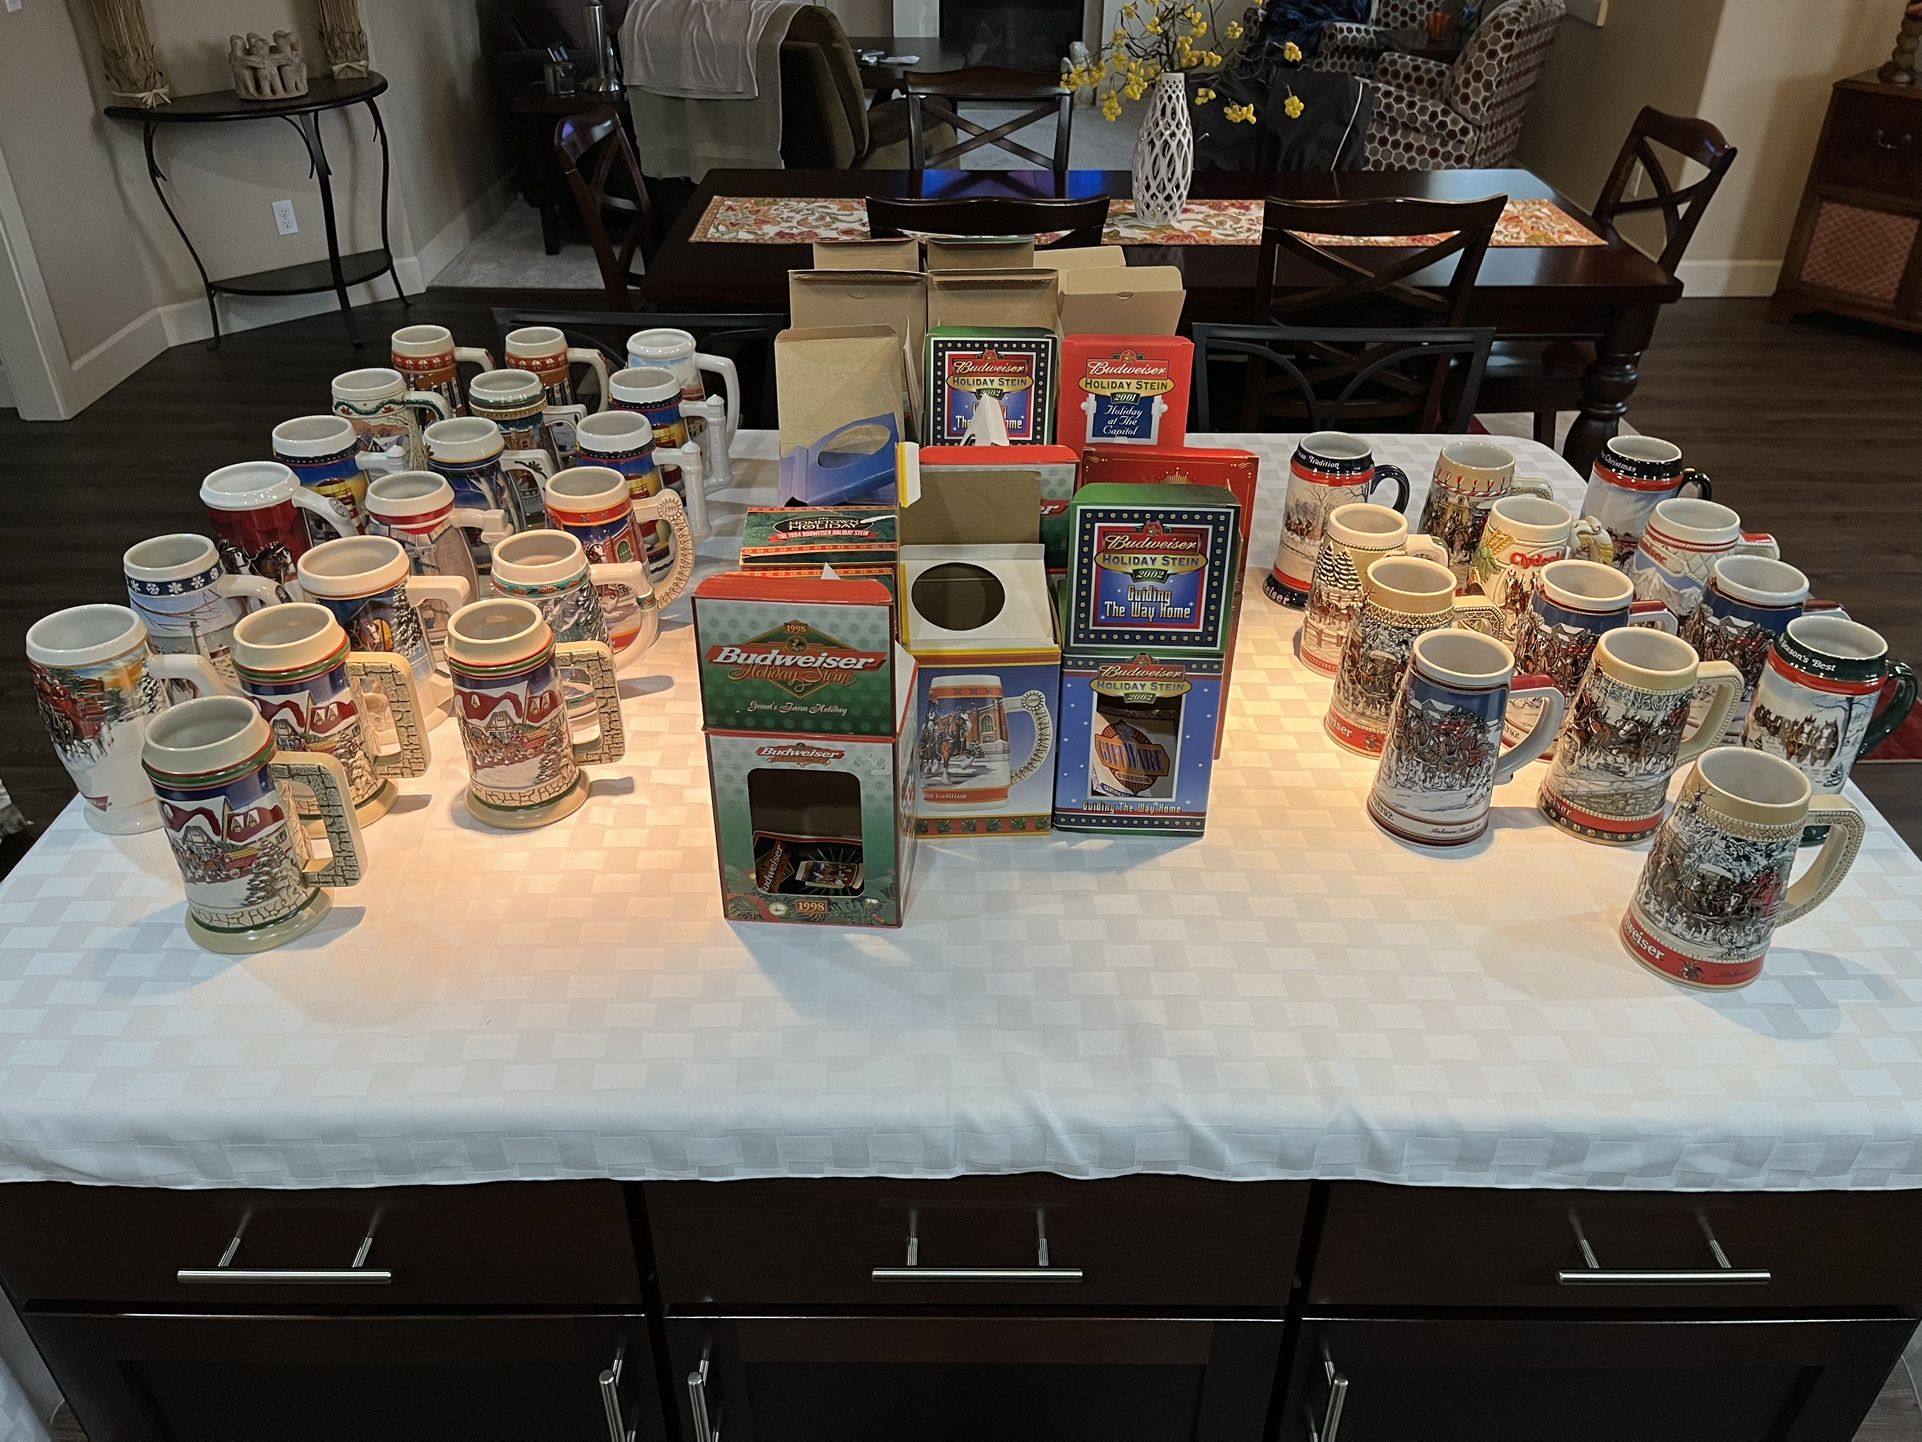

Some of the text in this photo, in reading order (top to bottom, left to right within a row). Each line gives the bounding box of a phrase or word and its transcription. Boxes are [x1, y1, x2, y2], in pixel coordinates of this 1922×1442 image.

[954, 361, 1025, 373] Budweiser
[1088, 361, 1167, 375] Budweiser
[953, 377, 1027, 387] HOLIDAY STEIN
[1085, 379, 1168, 390] HOLIDAY STEIN
[1114, 394, 1137, 402] 2001
[1104, 405, 1143, 419] Holiday
[1108, 416, 1138, 425] at The
[1103, 425, 1139, 436] Capitol
[1308, 455, 1340, 469] Tradition
[1105, 535, 1197, 550] Budweiser
[1103, 555, 1200, 567] HOLIDAY STEIN
[1136, 570, 1164, 579] 2002
[1127, 585, 1172, 607] Guiding
[1104, 600, 1191, 622] The Way Home
[786, 624, 807, 633] 1998
[713, 646, 875, 670] Budweiser
[1099, 665, 1182, 678] Budweiser
[1812, 659, 1837, 672] Best
[728, 664, 857, 693] Holiday Stein
[1097, 680, 1184, 691] HOLIDAY STEIN
[1127, 693, 1153, 701] 2002
[747, 700, 778, 712] Grant's
[809, 703, 848, 717] Holiday
[761, 747, 840, 758] Budweiser
[1082, 801, 1182, 814] Guiding The Way Home
[761, 844, 784, 893] udweiser
[798, 902, 826, 911] 1998
